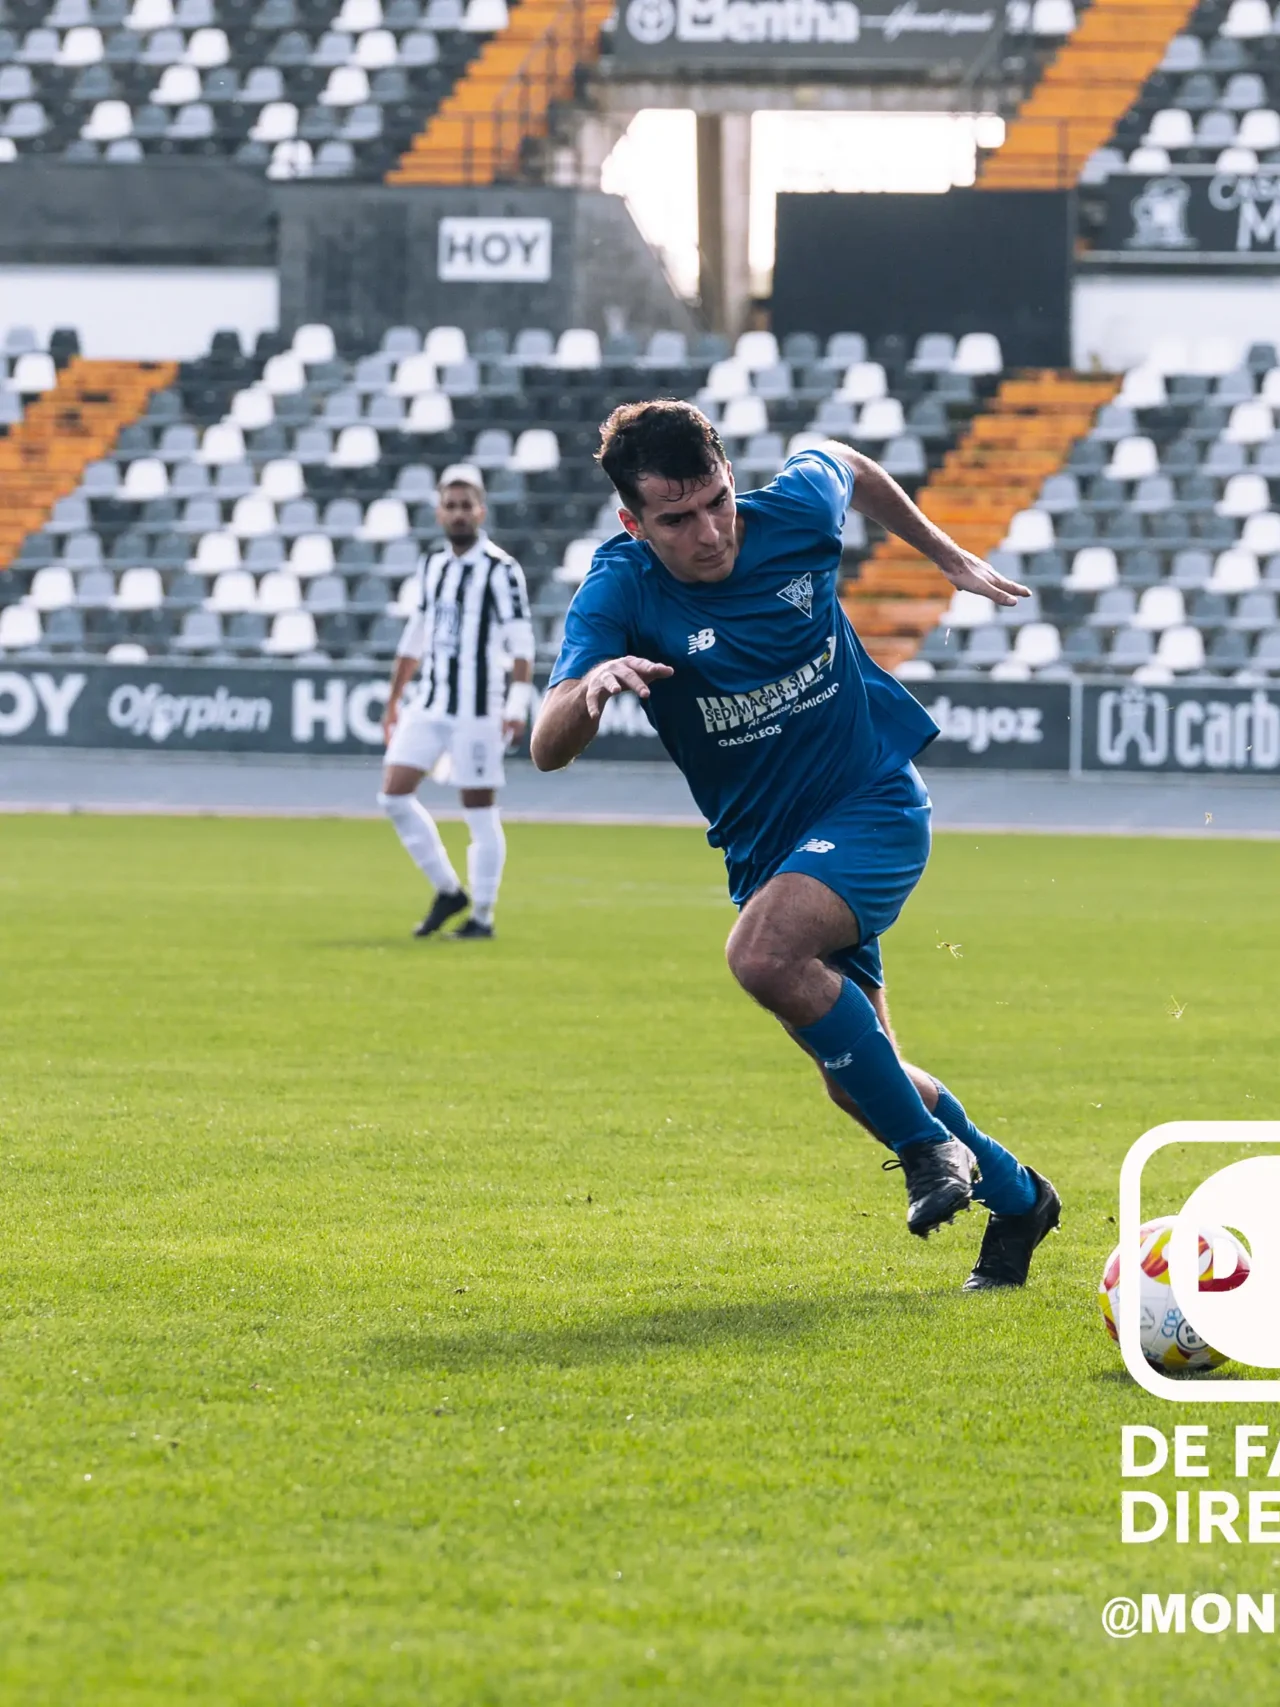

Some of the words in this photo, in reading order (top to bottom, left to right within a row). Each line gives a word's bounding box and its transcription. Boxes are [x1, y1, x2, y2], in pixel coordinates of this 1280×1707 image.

[448, 232, 541, 266] HOY
[0, 671, 87, 737] OY
[291, 678, 389, 745] HO
[718, 724, 782, 747] GASÓLEOS
[790, 682, 840, 717] OMICILIO
[925, 694, 1045, 754] dajoz
